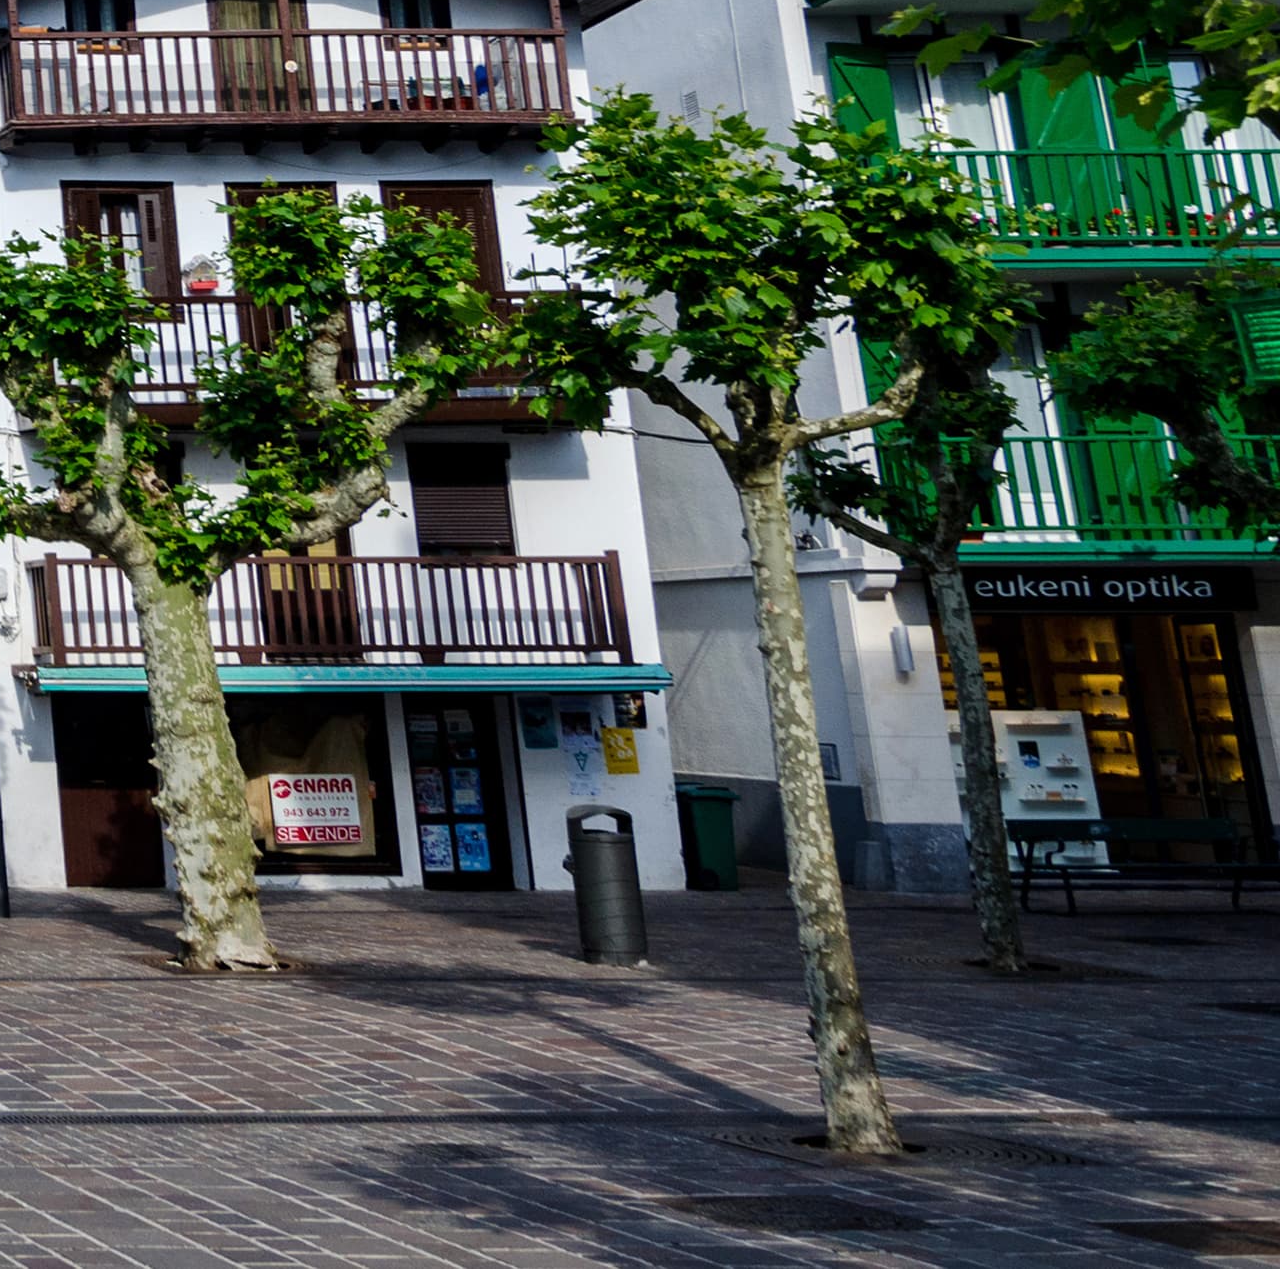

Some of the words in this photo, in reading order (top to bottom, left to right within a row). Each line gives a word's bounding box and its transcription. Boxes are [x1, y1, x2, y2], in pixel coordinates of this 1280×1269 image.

[974, 574, 1091, 598] eukeni
[1103, 574, 1213, 602] optika
[293, 778, 353, 793] ENARA
[283, 808, 304, 817] 943
[306, 807, 327, 817] 643
[329, 807, 350, 816] 972
[277, 827, 300, 841] SE
[302, 826, 359, 840] VENDE
